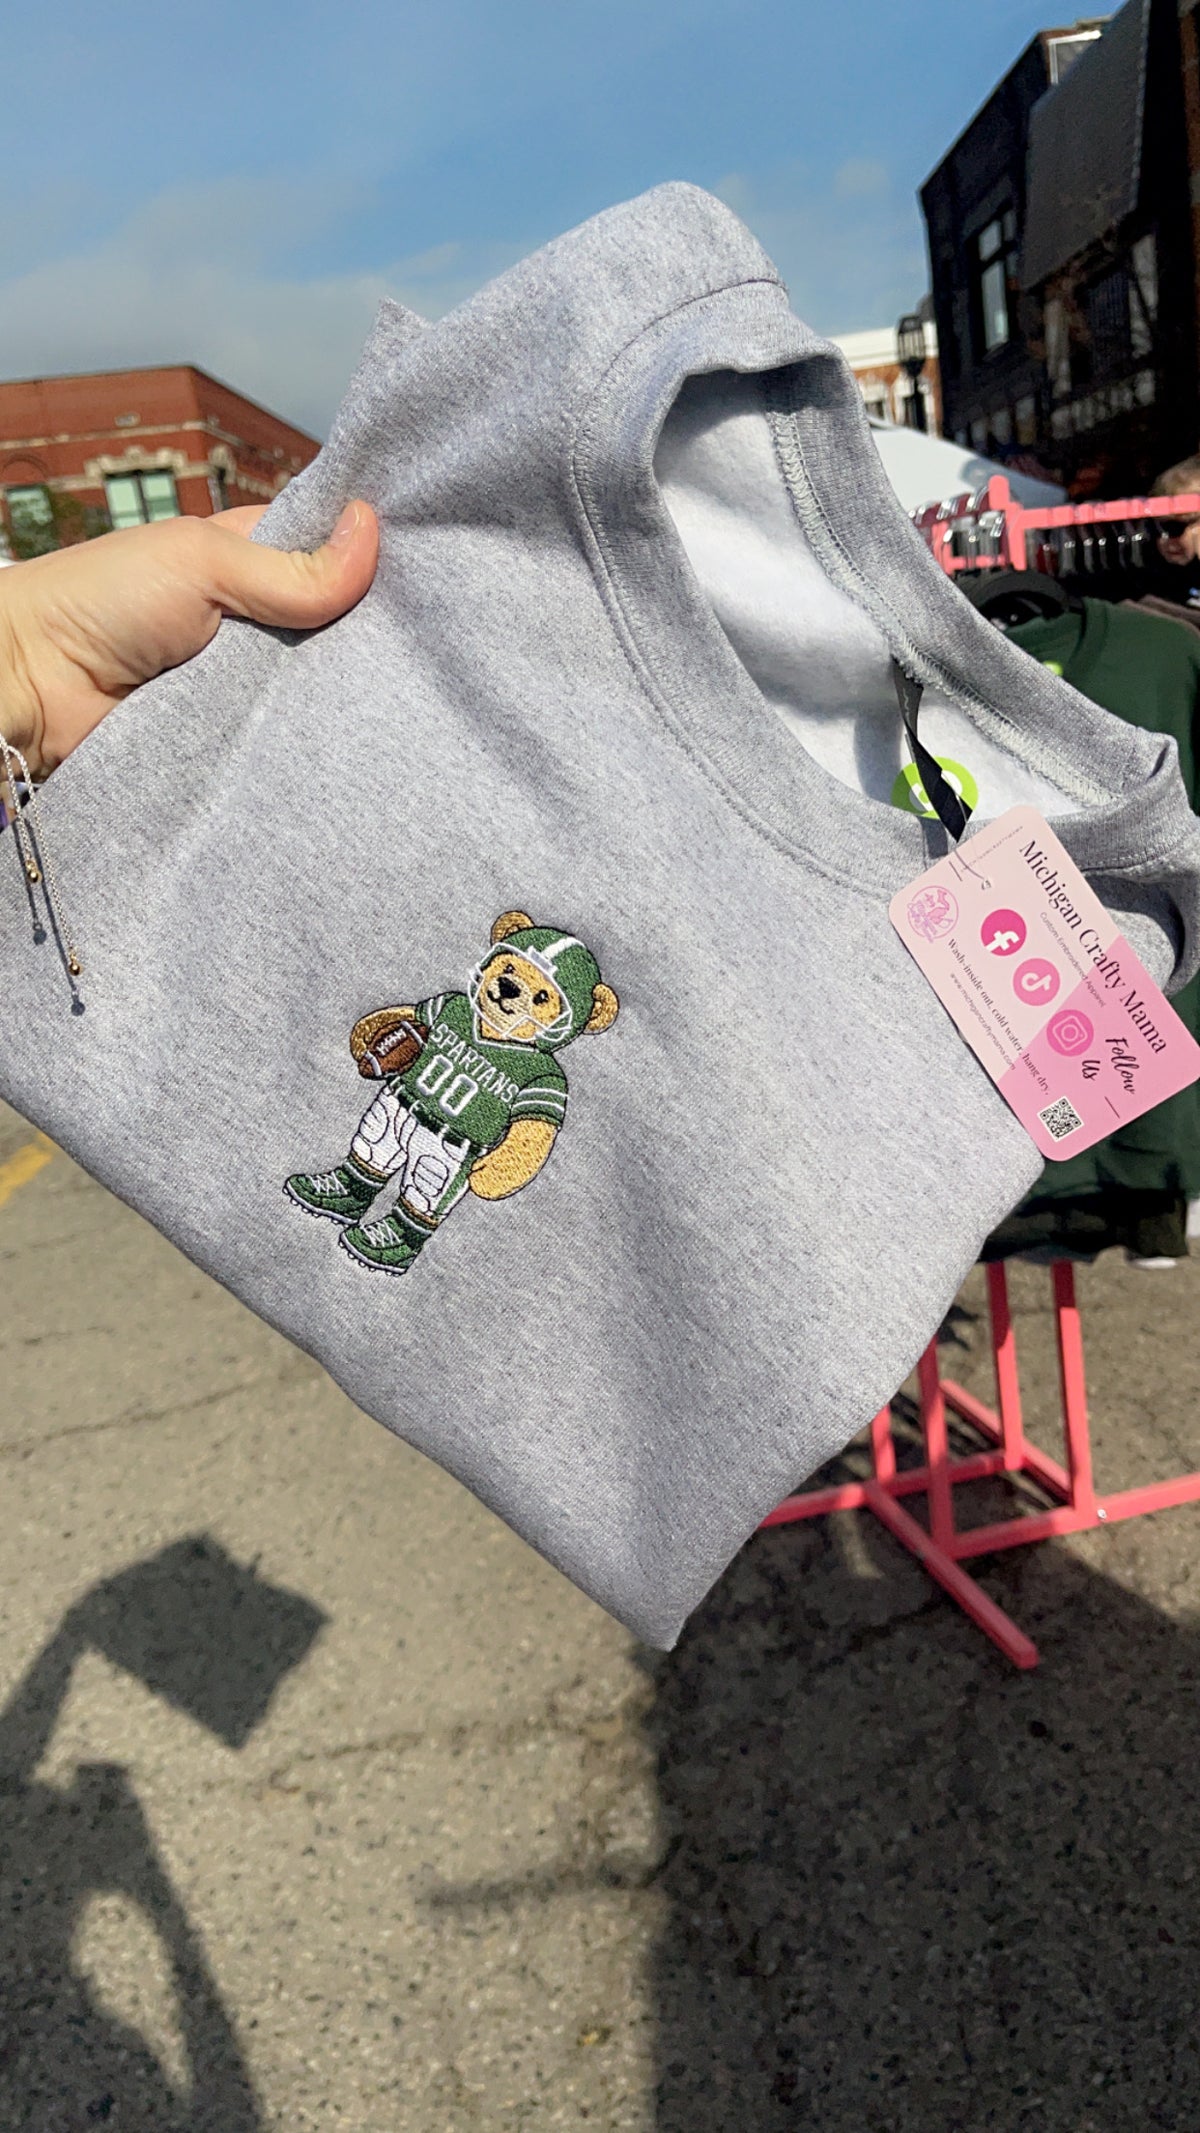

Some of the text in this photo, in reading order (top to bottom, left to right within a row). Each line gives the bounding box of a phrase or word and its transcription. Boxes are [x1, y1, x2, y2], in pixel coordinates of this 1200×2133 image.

[1019, 840, 1167, 1054] Michigan Crafty Mama
[1040, 912, 1106, 1007] Custom Embroidered Apparel
[430, 1023, 519, 1103] SPARTANS
[991, 1008, 1009, 1028] cold
[1022, 1053, 1040, 1077] hang
[1081, 1060, 1101, 1081] Us
[1105, 1037, 1139, 1094] Follow
[416, 1054, 479, 1117] 00
